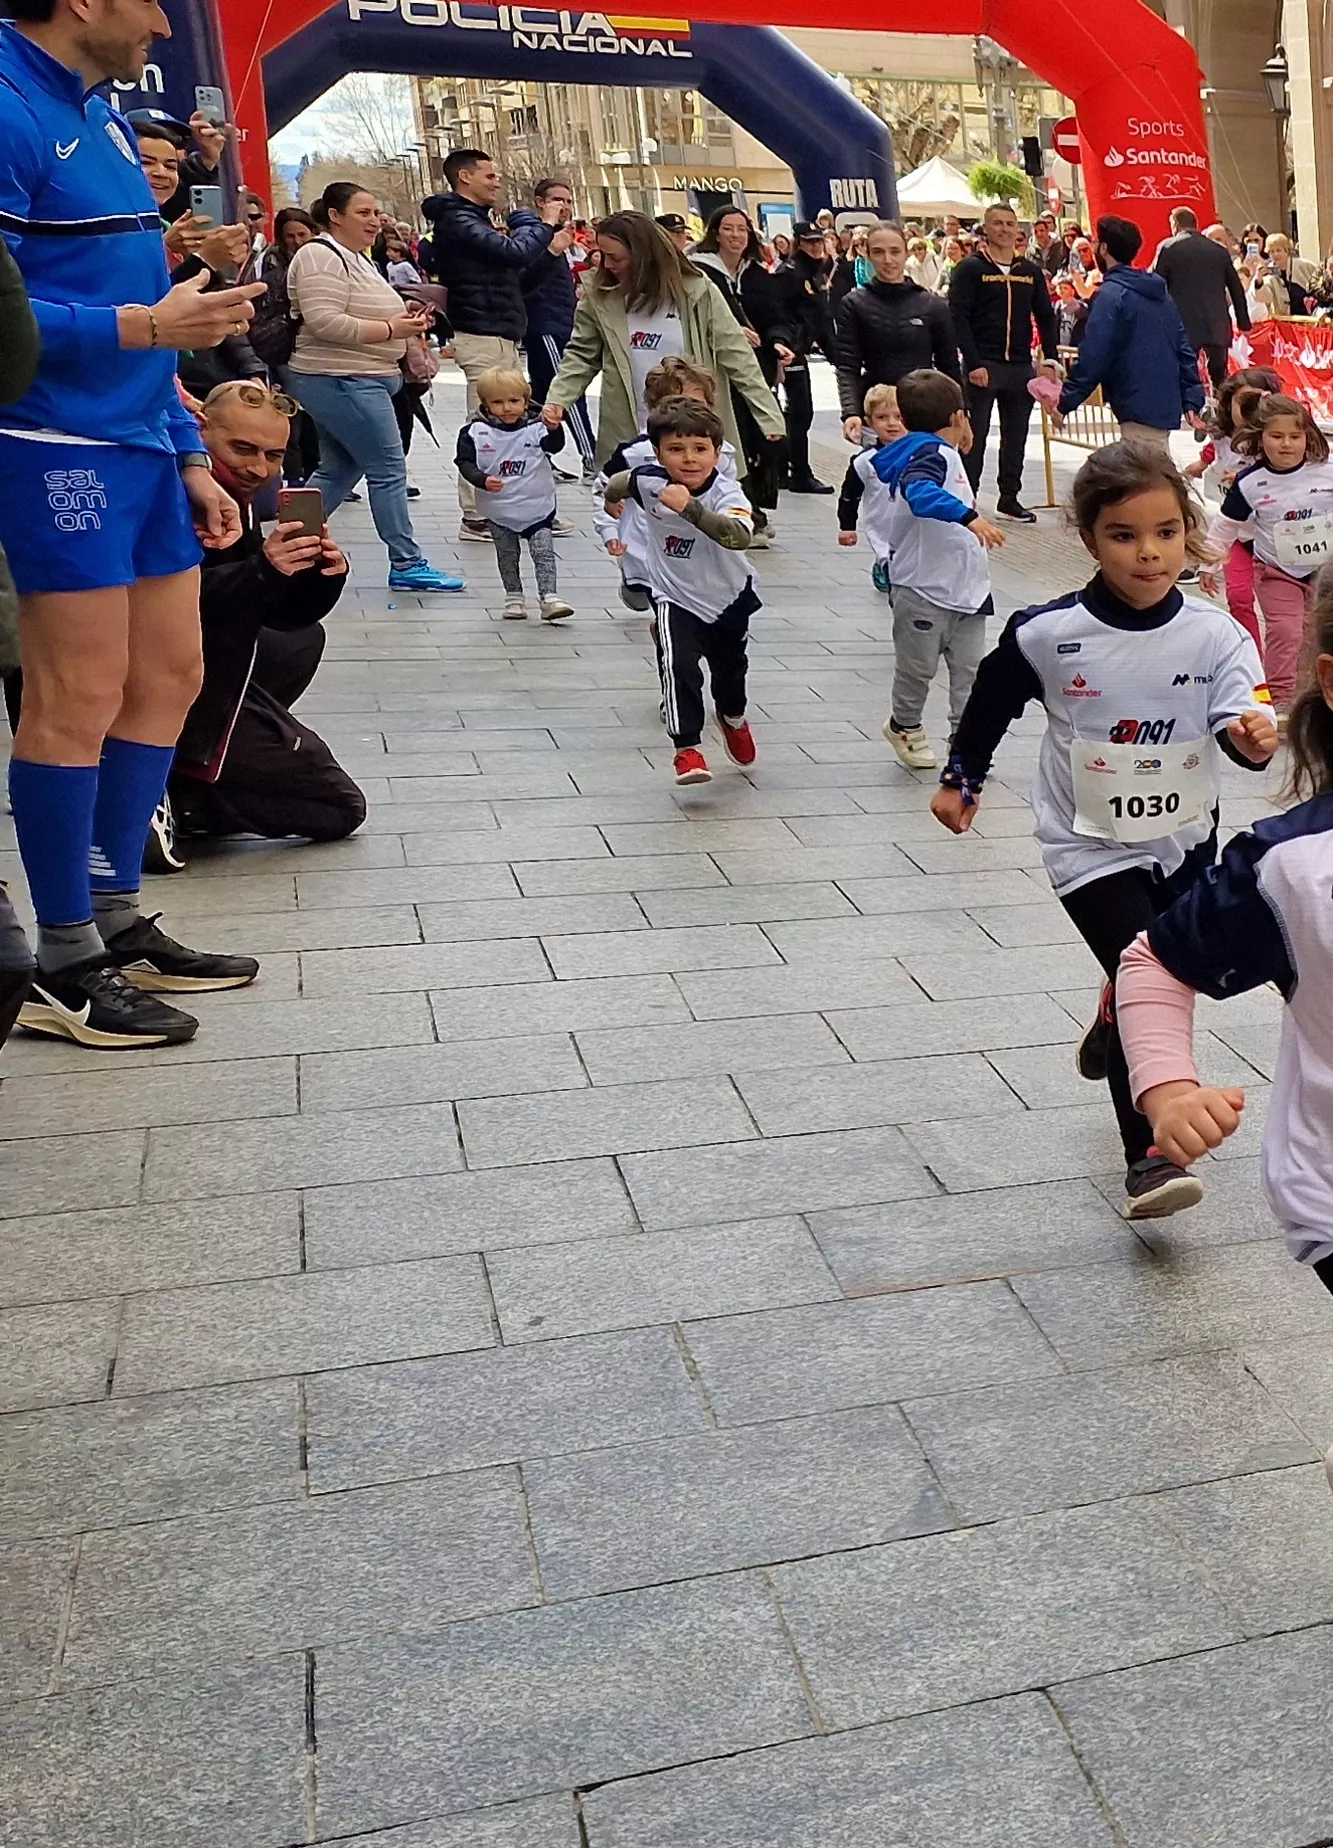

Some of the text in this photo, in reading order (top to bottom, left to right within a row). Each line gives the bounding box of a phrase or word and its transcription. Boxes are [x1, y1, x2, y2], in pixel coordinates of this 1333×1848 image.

[512, 31, 693, 58] NACIONAL
[1127, 117, 1185, 139] Sports
[1126, 147, 1206, 169] Santander
[673, 175, 743, 192] MANGO
[829, 179, 880, 208] RUTA
[55, 511, 101, 531] on
[1295, 541, 1328, 555] 1041
[1108, 792, 1180, 818] 1030
